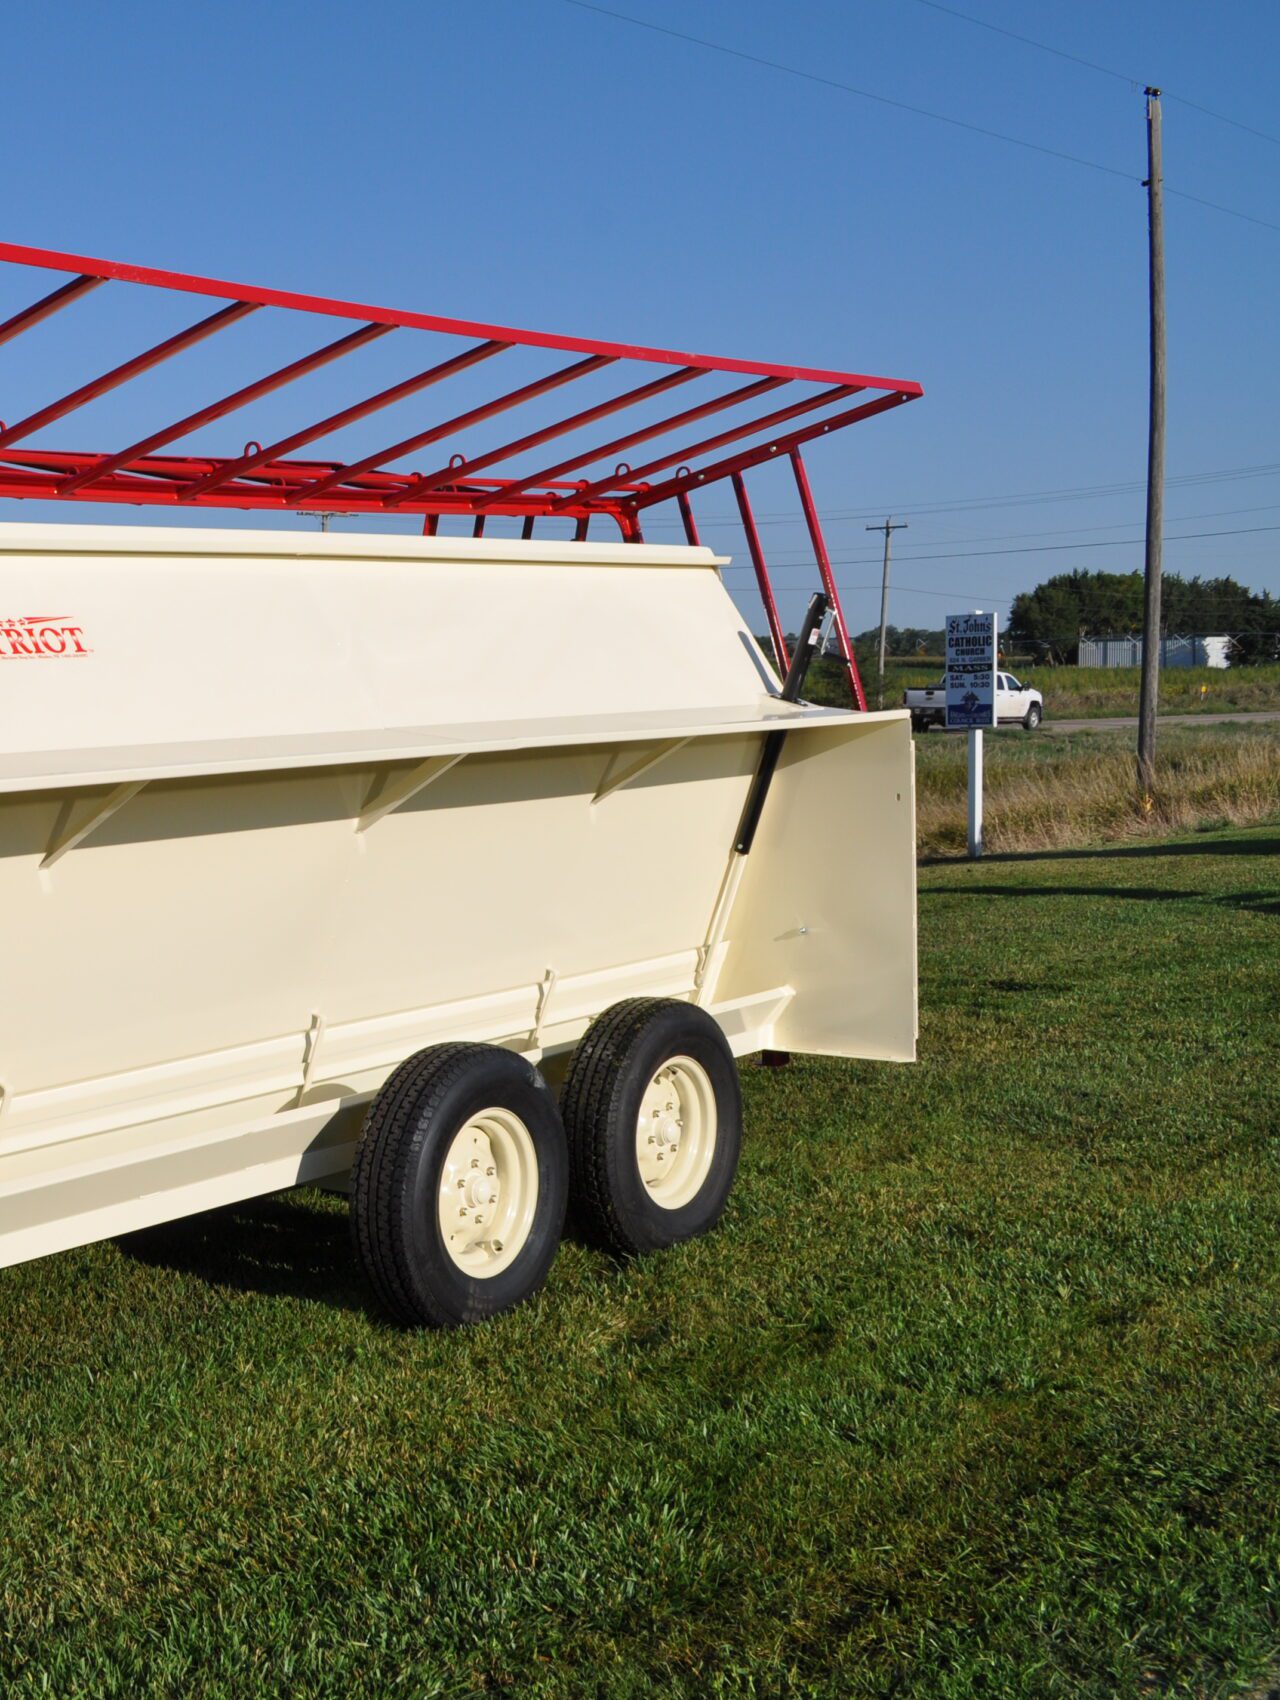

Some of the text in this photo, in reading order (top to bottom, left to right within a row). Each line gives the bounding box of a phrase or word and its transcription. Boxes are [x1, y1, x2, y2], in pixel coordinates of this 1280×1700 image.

[963, 615, 992, 634] John's
[948, 635, 992, 648] CATHOLIC
[955, 648, 985, 656] CHURCH
